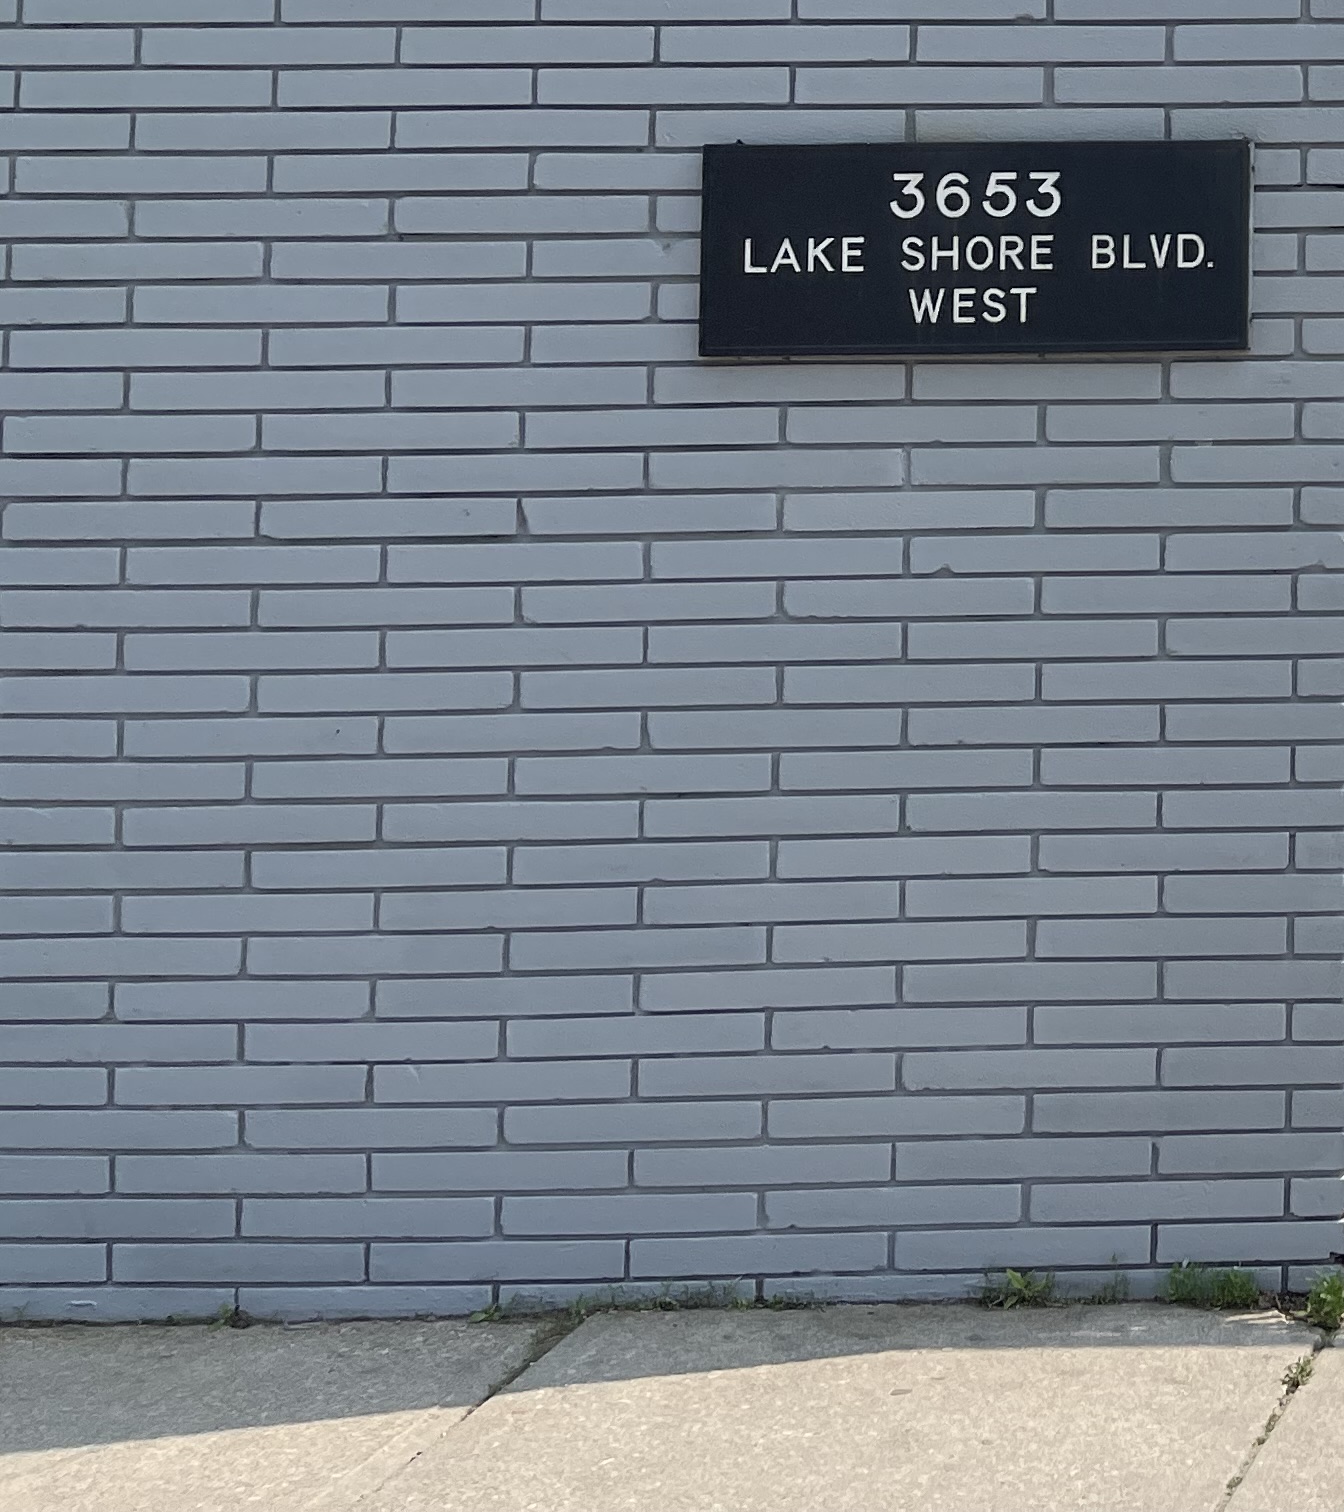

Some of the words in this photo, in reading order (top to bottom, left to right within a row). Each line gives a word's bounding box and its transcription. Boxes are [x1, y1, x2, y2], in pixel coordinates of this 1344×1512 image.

[889, 171, 1061, 219] 3653
[744, 236, 865, 274] LAKE
[900, 234, 1054, 271] SHORE
[1091, 233, 1214, 269] BLVD.
[908, 287, 1037, 324] WEST
